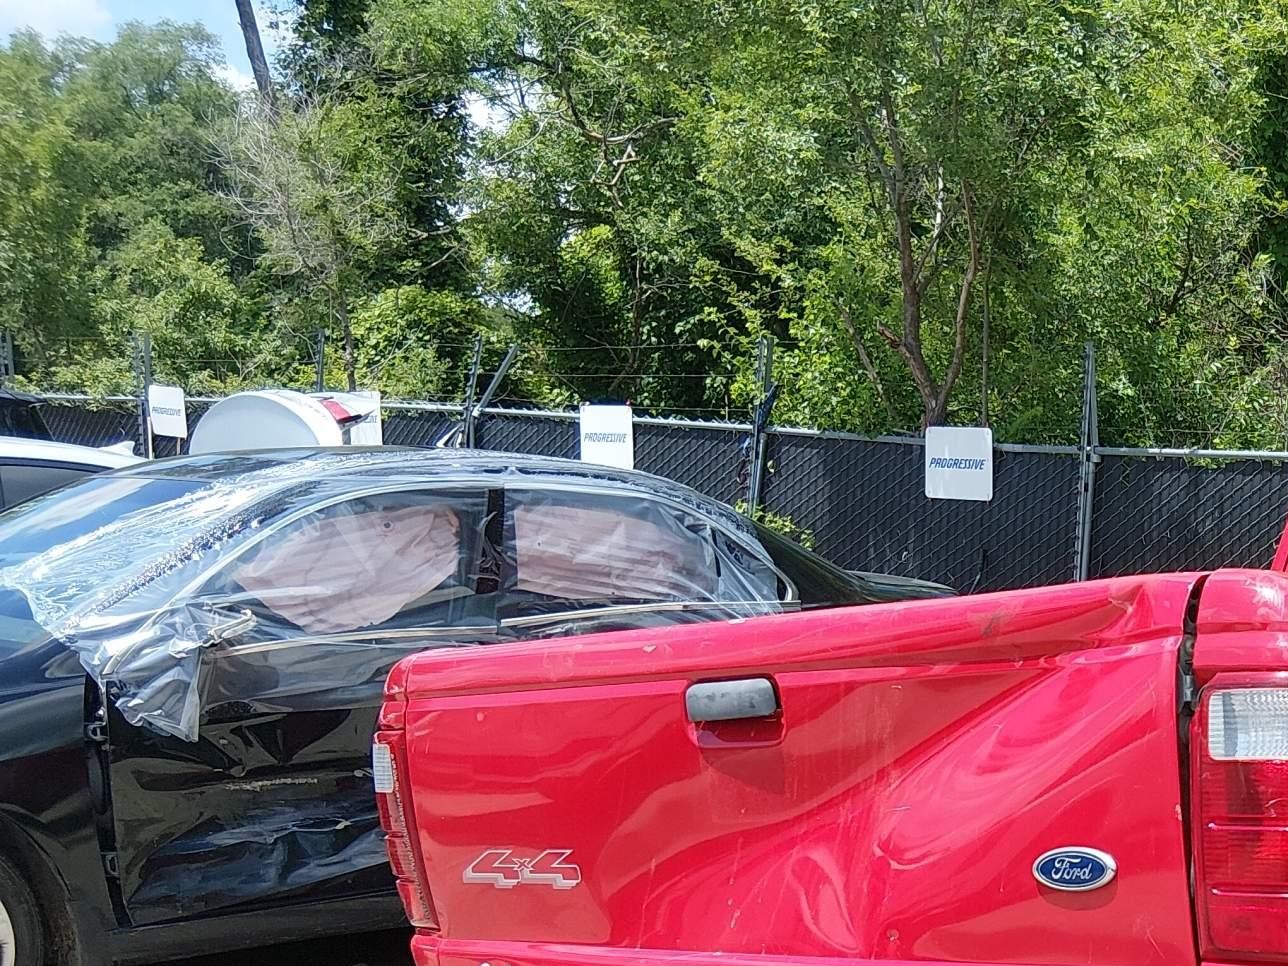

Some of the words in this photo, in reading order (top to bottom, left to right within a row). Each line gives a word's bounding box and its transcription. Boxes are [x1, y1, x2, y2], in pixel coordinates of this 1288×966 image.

[584, 432, 628, 443] PROGRESSIVE
[929, 457, 987, 470] PROGRESSIVE
[1051, 857, 1093, 880] Ford
